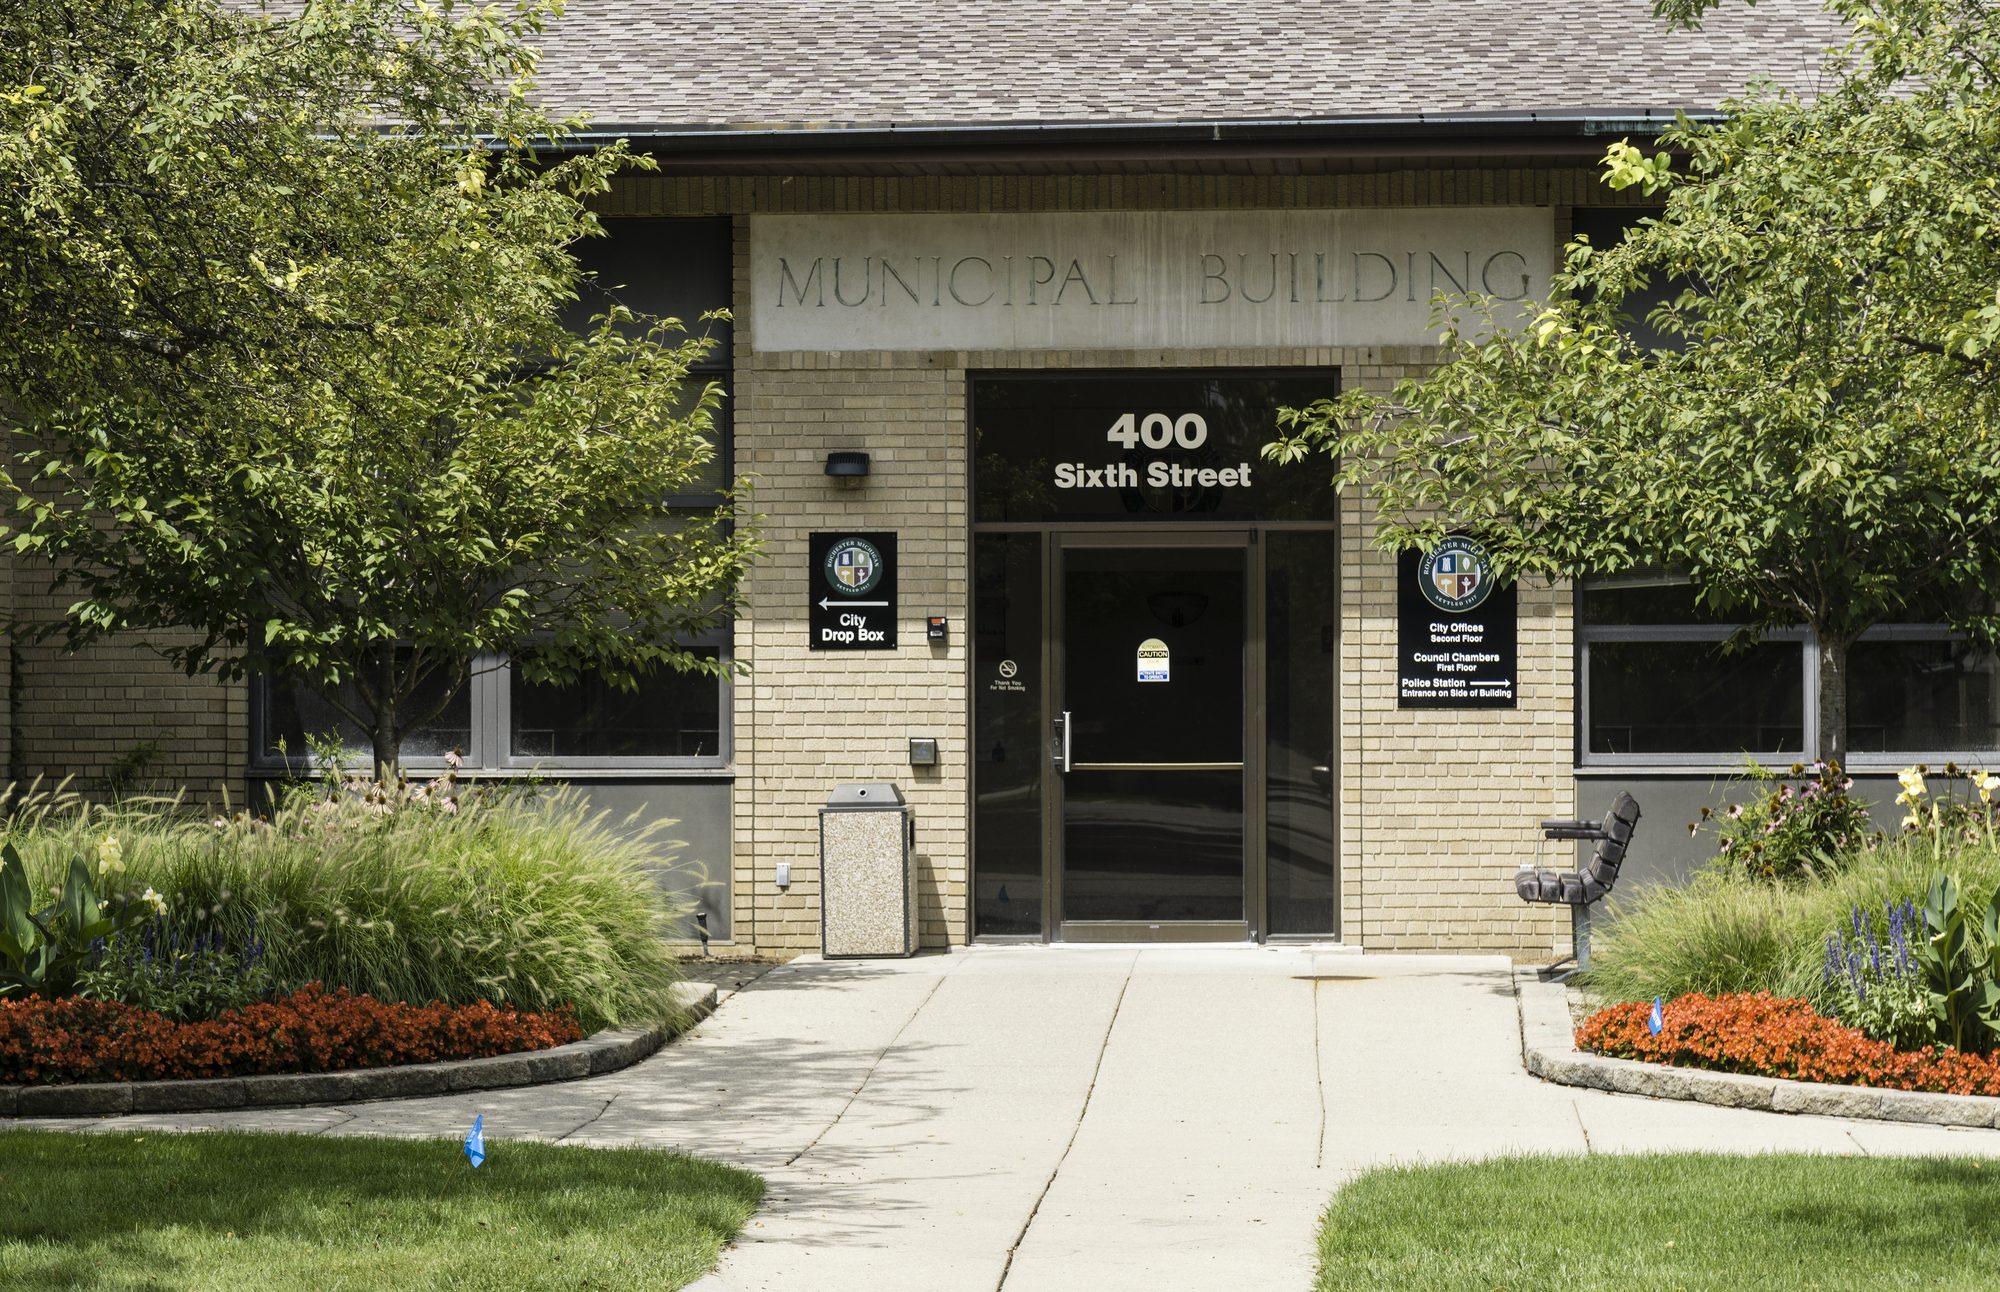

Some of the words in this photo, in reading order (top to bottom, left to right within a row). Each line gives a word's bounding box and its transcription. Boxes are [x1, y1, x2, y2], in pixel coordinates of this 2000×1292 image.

[776, 254, 1139, 307] MUNICIPAL
[1199, 250, 1531, 306] BUILDING
[1107, 412, 1208, 450] 400
[1054, 462, 1138, 489] Sixth
[1146, 461, 1252, 488] Street
[827, 540, 855, 568] ROCHESTER
[856, 541, 880, 568] MICHIGAN
[1423, 541, 1458, 575] ROCHESTER
[1435, 594, 1464, 607] SETTLED
[840, 613, 866, 628] City
[1429, 622, 1449, 635] City
[1450, 622, 1484, 633] Offices
[822, 628, 855, 644] Drop
[858, 628, 885, 641] Box
[1430, 634, 1461, 643] Second
[1462, 634, 1483, 643] Floor
[1413, 652, 1450, 663] Council
[1451, 652, 1500, 662] Chambers
[1436, 663, 1455, 672] First
[1456, 663, 1478, 672] Floor
[1401, 678, 1431, 688] Police
[1432, 678, 1466, 688] Station
[1401, 688, 1437, 697] Entrance
[1438, 689, 1449, 697] on
[1450, 688, 1468, 697] Side
[1469, 688, 1479, 697] of
[1479, 688, 1512, 699] Building
